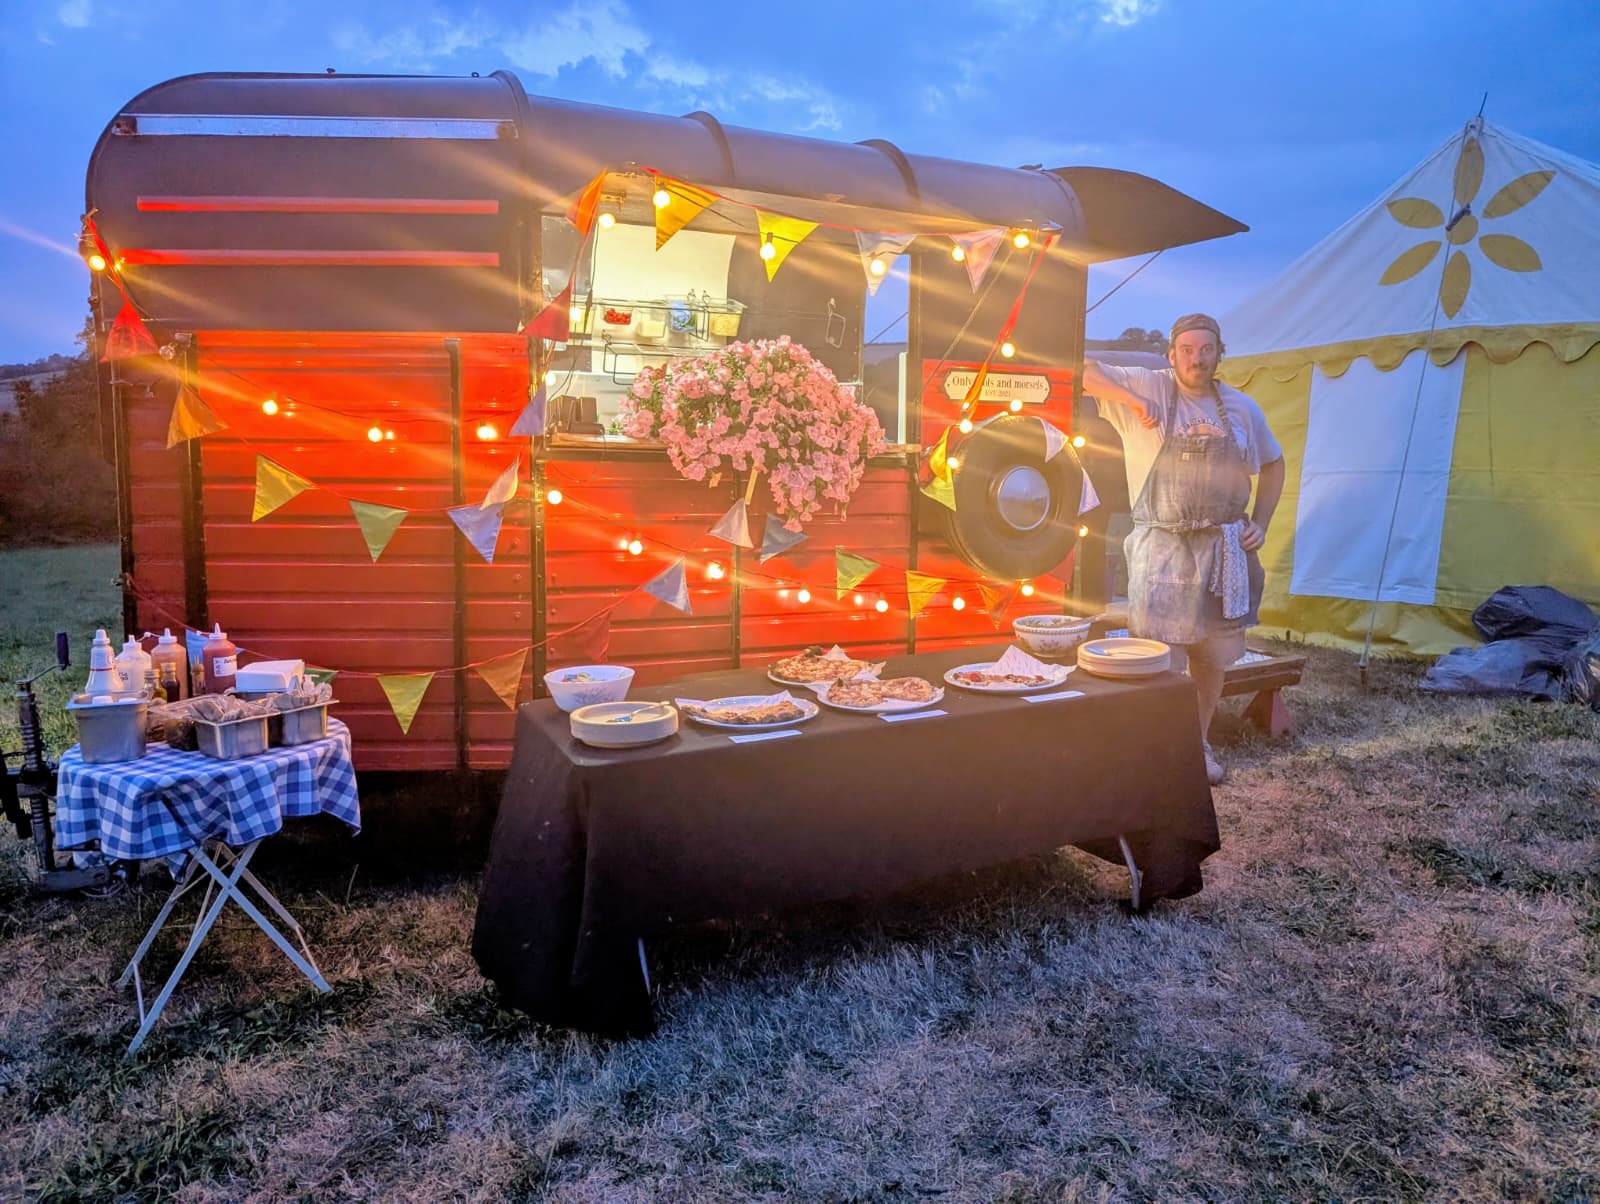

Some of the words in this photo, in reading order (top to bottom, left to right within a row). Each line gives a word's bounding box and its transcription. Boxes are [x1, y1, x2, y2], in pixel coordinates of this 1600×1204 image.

[952, 376, 972, 389] Only
[996, 377, 1012, 389] and
[1014, 379, 1044, 390] morsels
